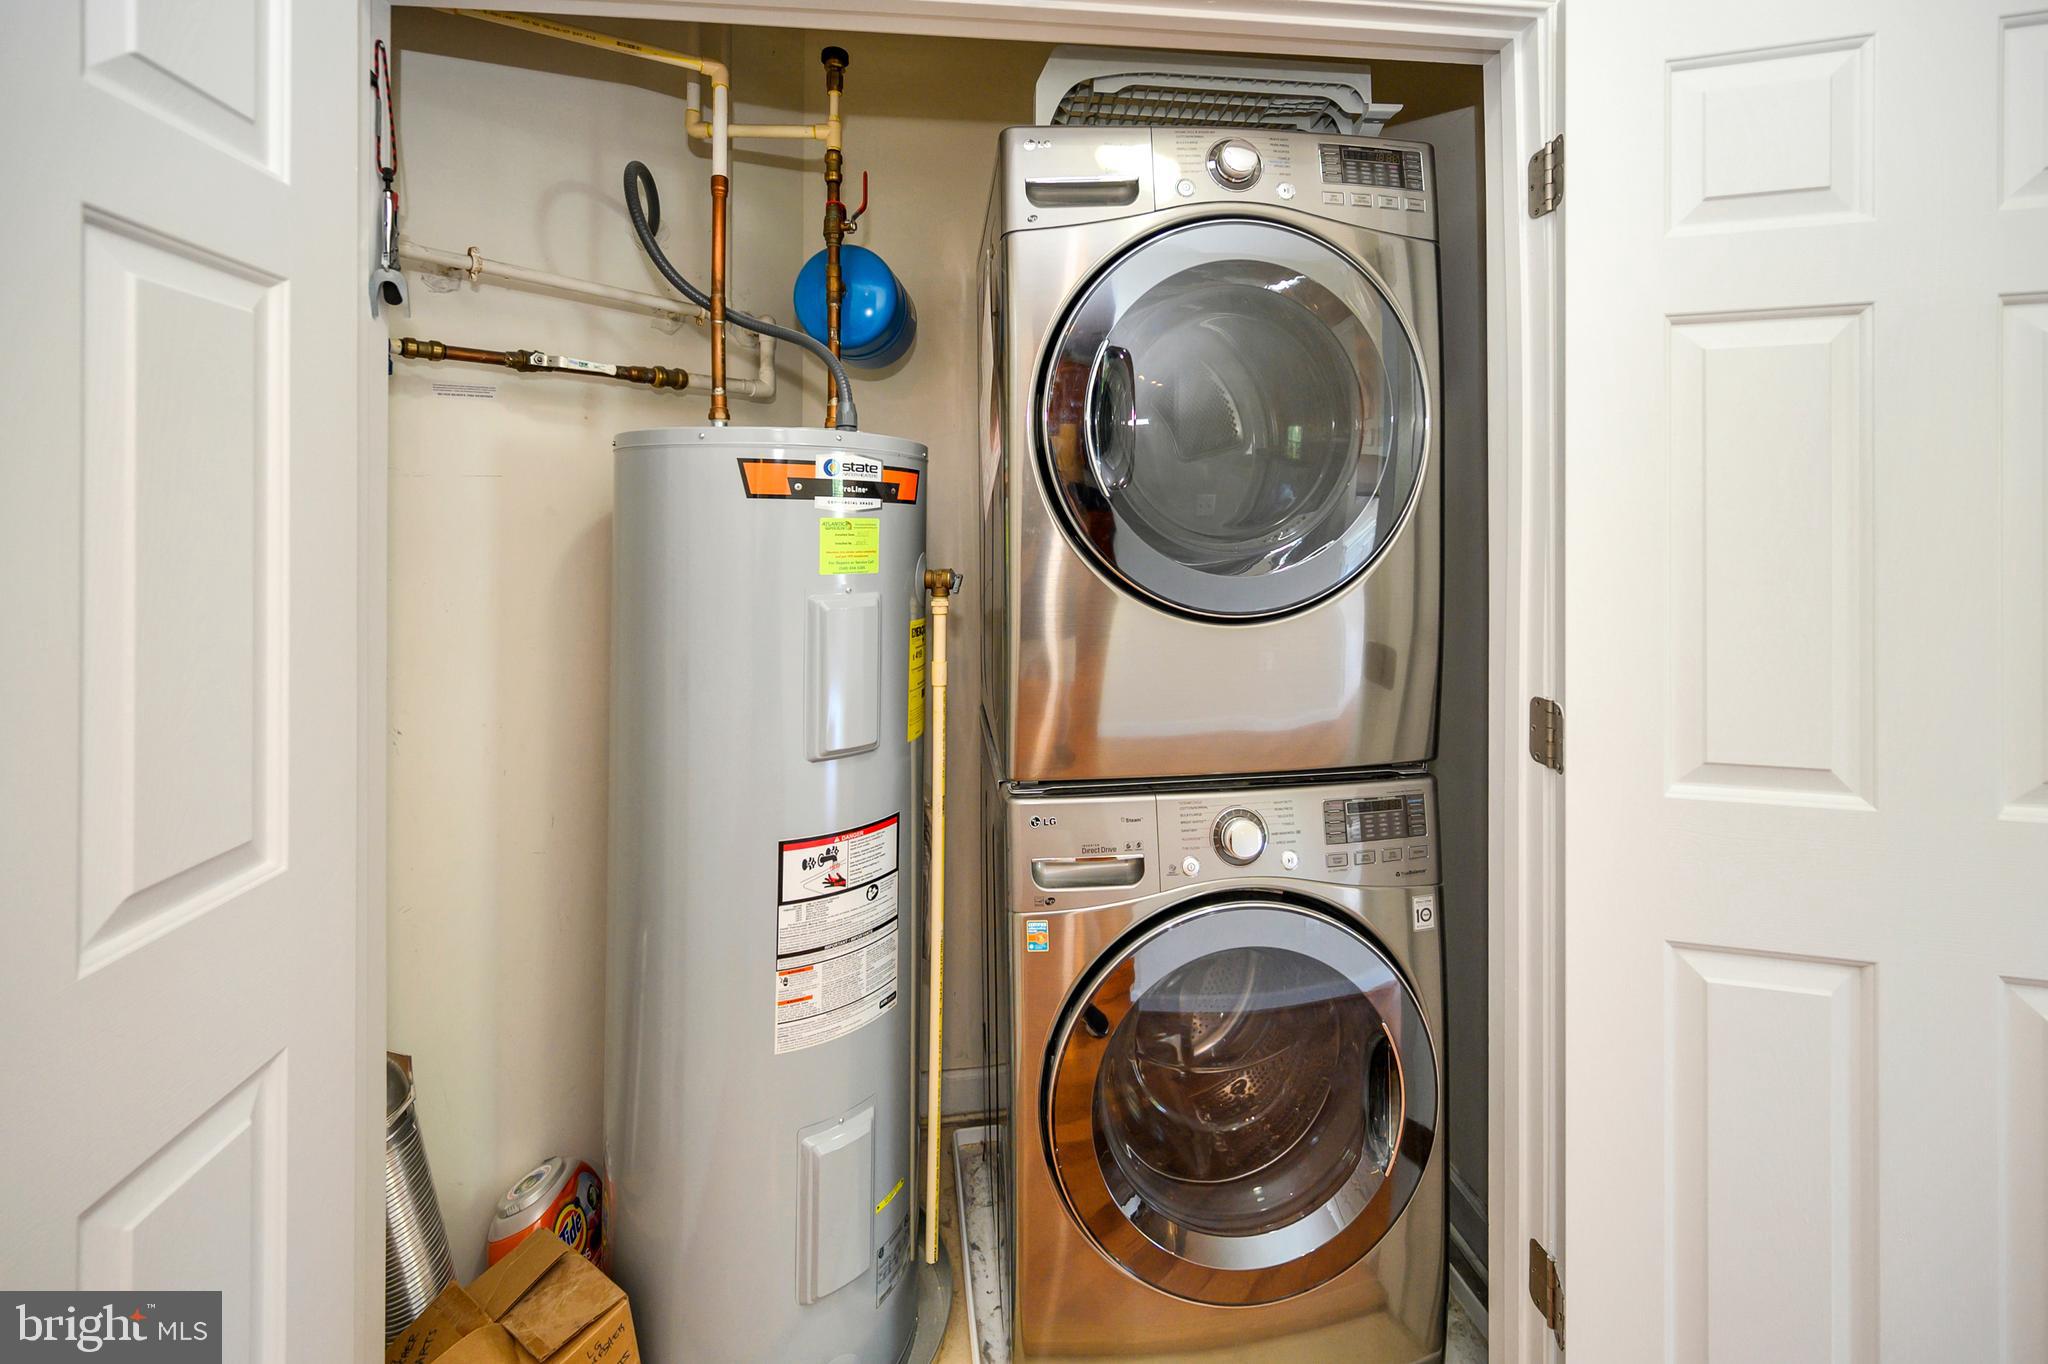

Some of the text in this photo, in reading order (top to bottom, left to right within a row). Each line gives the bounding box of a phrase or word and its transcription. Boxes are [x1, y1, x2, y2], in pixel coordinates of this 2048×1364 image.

[842, 462, 878, 474] state
[1043, 817, 1057, 826] LG
[841, 830, 865, 841] DANGER
[559, 1212, 582, 1246] Tide
